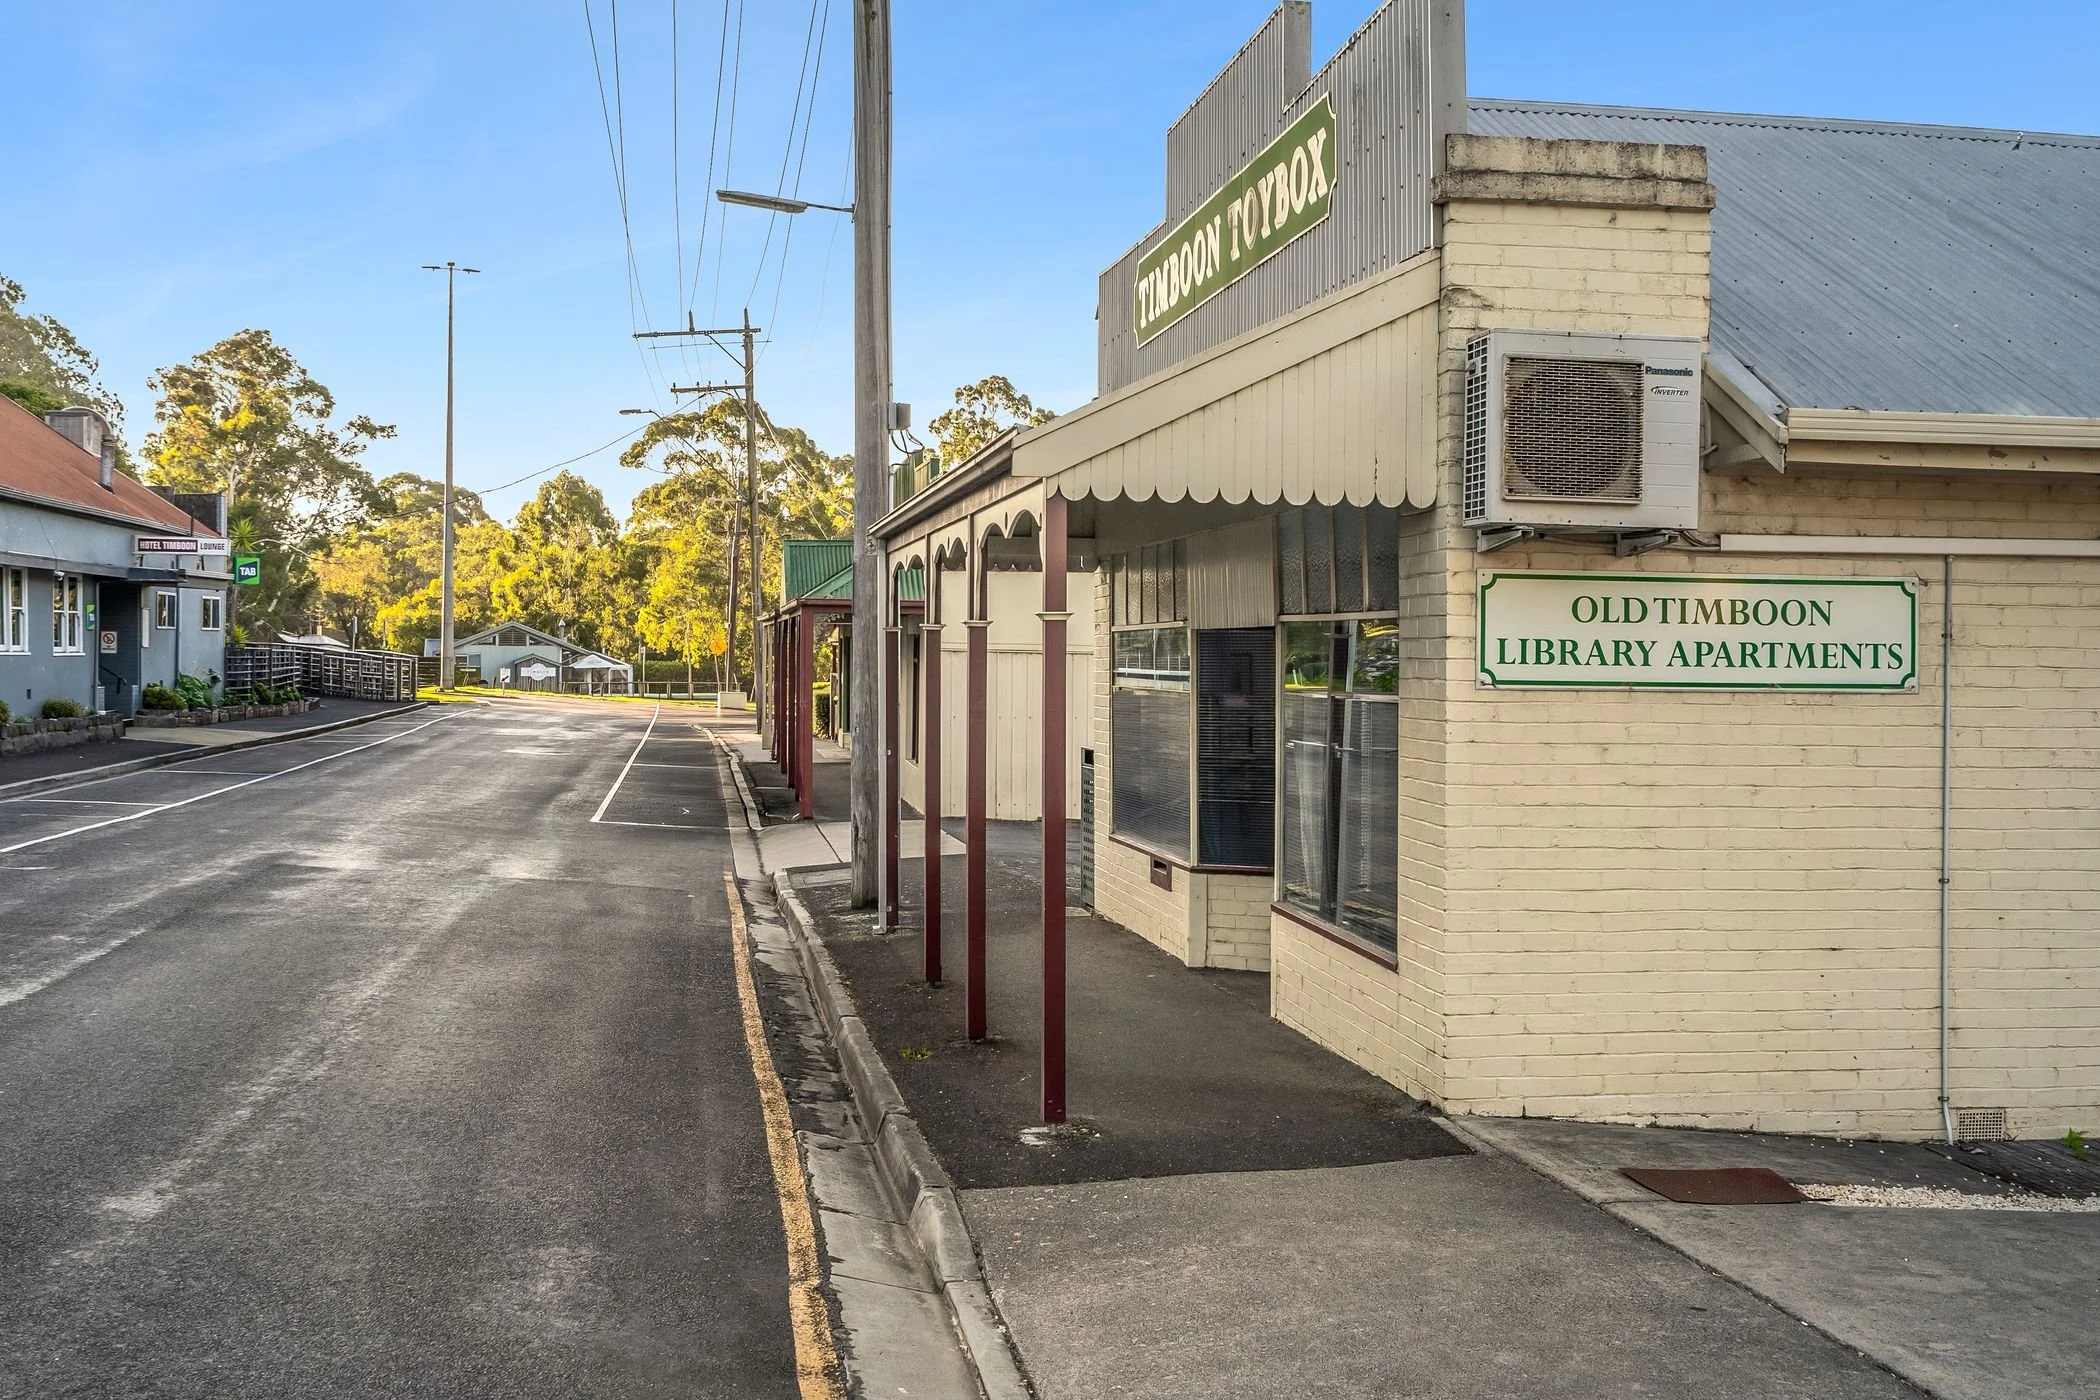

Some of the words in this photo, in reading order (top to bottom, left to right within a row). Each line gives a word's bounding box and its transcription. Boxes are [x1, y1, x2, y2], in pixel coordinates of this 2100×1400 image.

[1138, 214, 1221, 329] TIMBOON
[1227, 127, 1328, 262] TOYBOX
[1645, 366, 1693, 376] Panasonic
[1653, 388, 1689, 396] INVERTER
[140, 541, 162, 550] HOTEL
[162, 541, 197, 550] TIMBOON
[200, 542, 225, 551] LOUNGE
[239, 567, 257, 576] TAB
[1571, 595, 1649, 624] OLD
[1653, 597, 1834, 627] TIMBOON
[1496, 637, 1658, 667] LIBRARY
[1666, 640, 1904, 670] APARTMENTS
